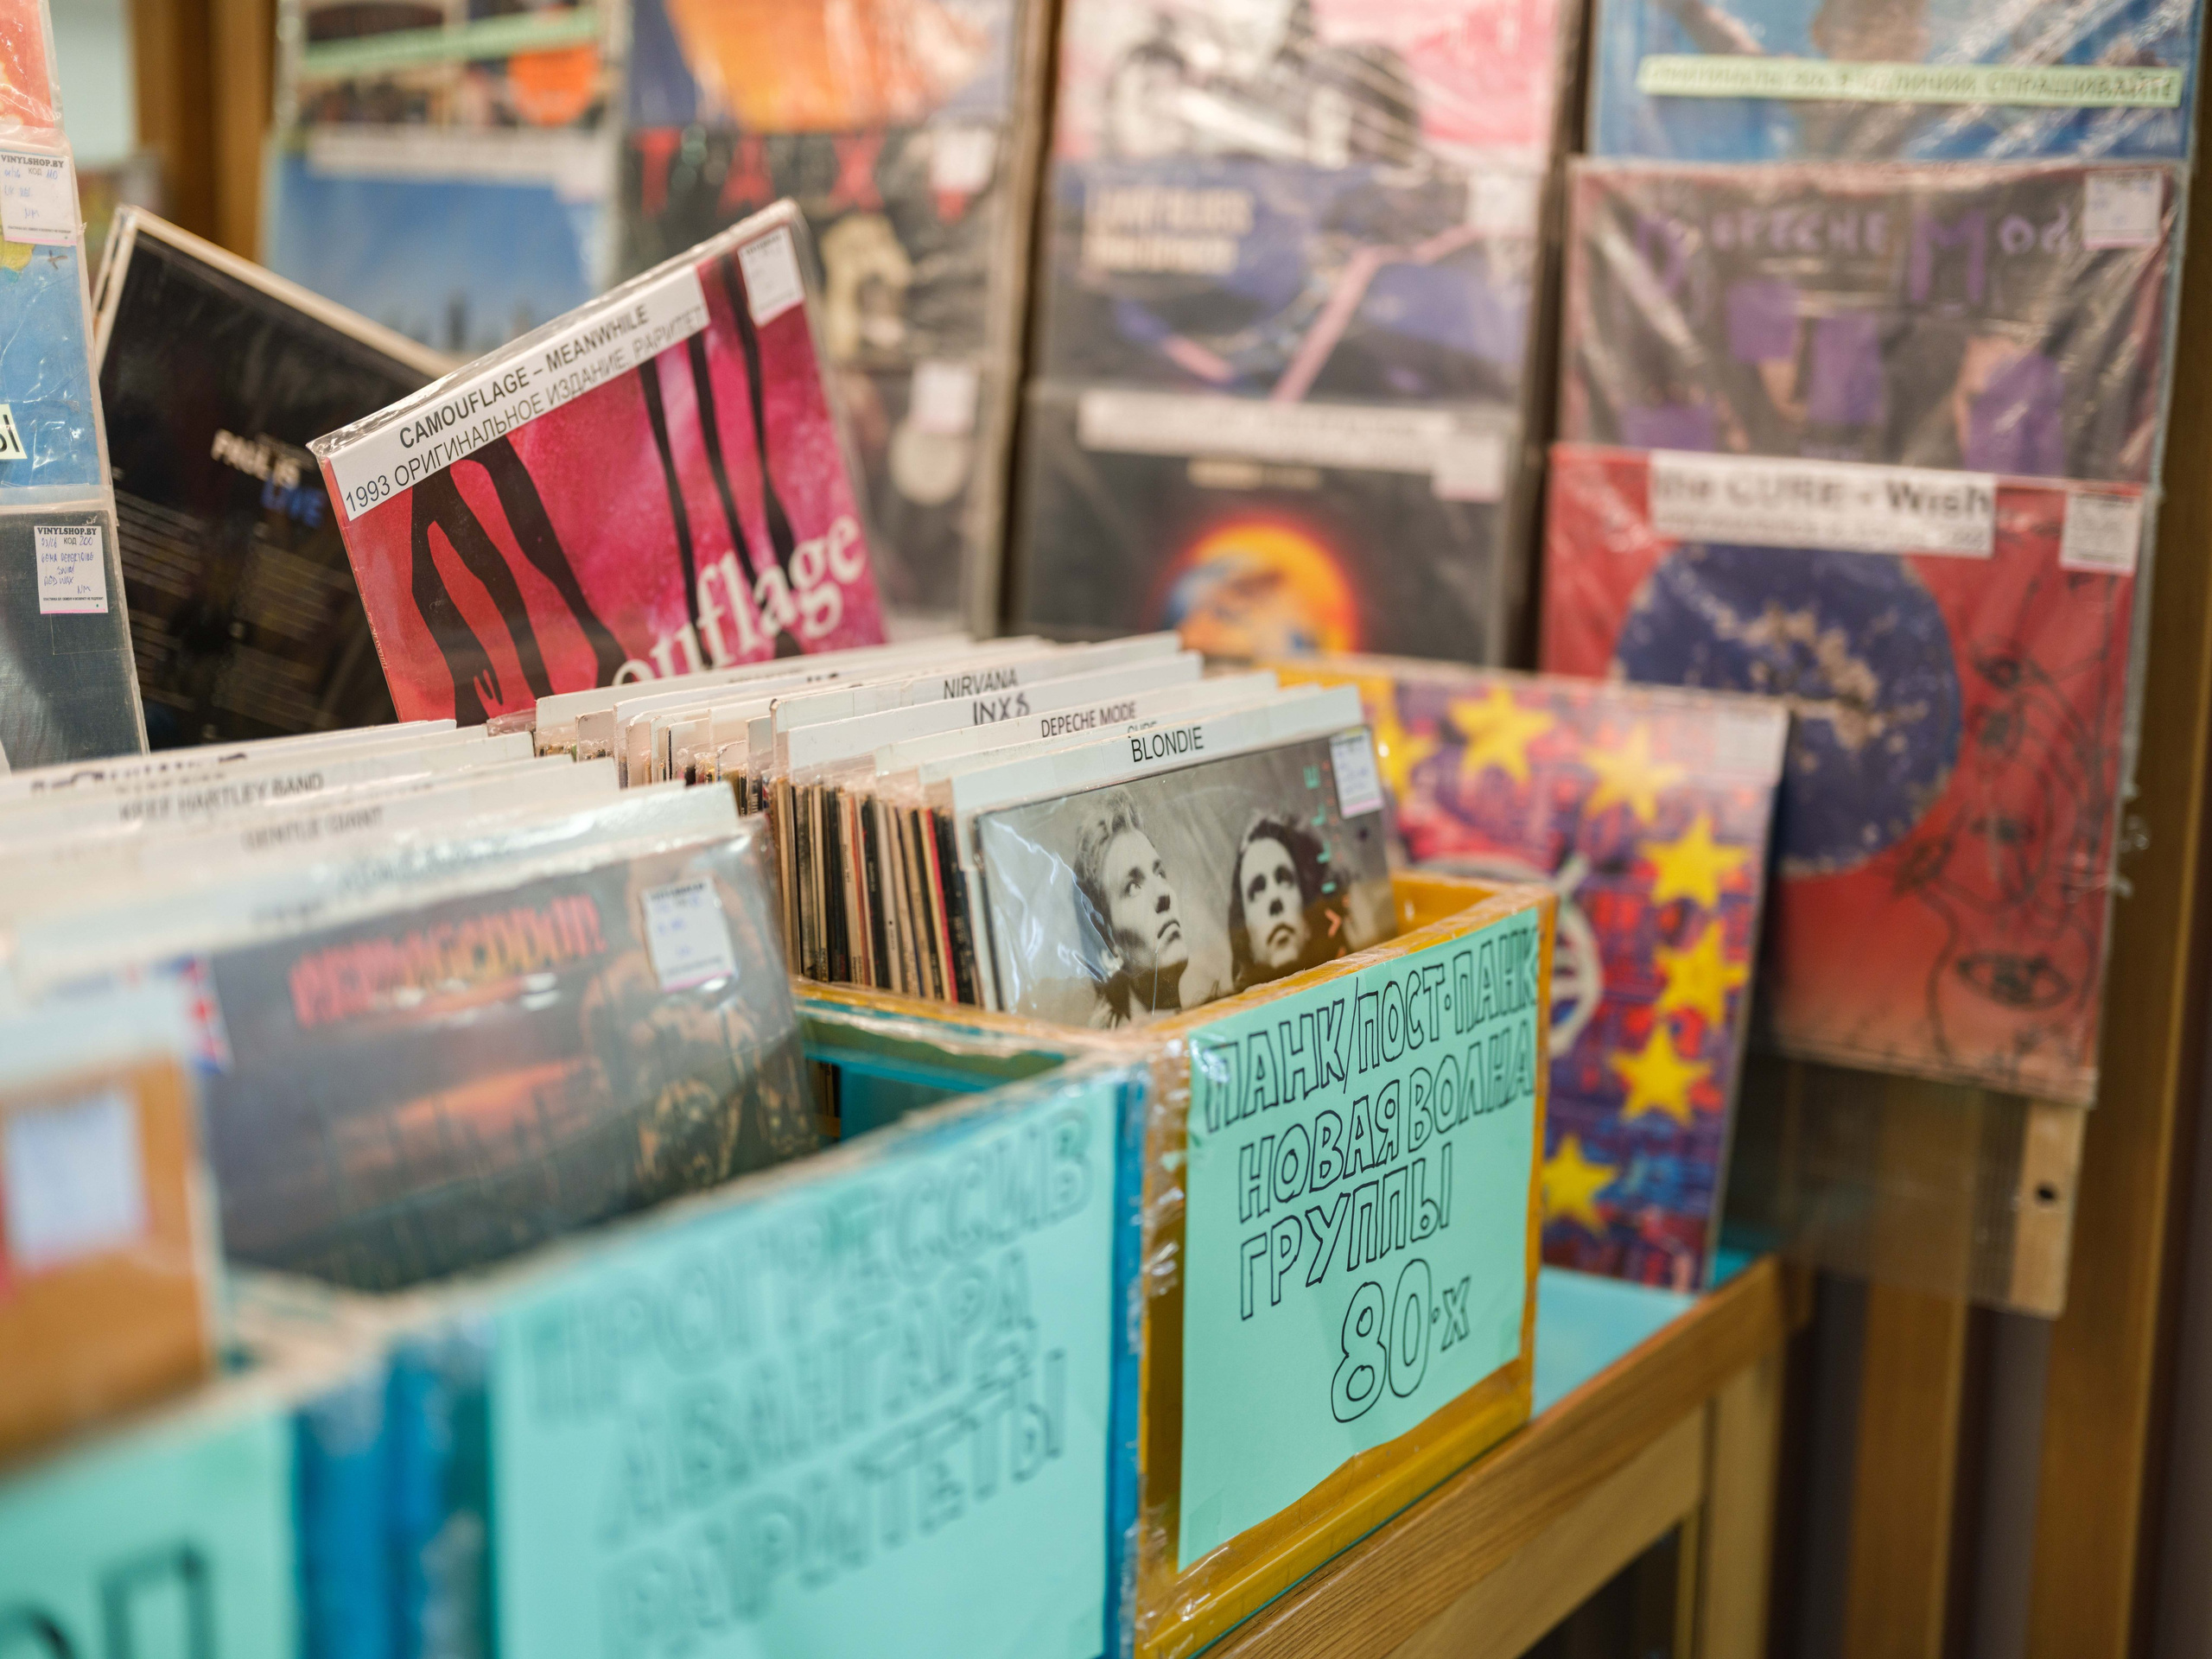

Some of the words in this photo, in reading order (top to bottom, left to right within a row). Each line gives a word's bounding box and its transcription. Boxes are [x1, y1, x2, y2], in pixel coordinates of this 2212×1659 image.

[1, 155, 64, 168] VINYLSHOP.BY
[399, 366, 530, 448] CAMOUFLAGE
[546, 304, 650, 371] MEANWHILE
[346, 474, 391, 512] 1993
[394, 393, 544, 486] ОРИГИНАЛЬНОЕ
[37, 527, 97, 536] VINYLSHOP.BY
[944, 668, 1019, 699] NIRVANA
[1040, 710, 1096, 738] DEPECHE
[1100, 701, 1137, 726] MODE
[1130, 727, 1205, 762] BLONDIE
[271, 772, 324, 798] BAND
[1238, 1079, 1400, 1224] НОВАЯ
[1407, 1019, 1535, 1154] ВОЛНА
[1240, 1141, 1452, 1320] ГРУППЫ
